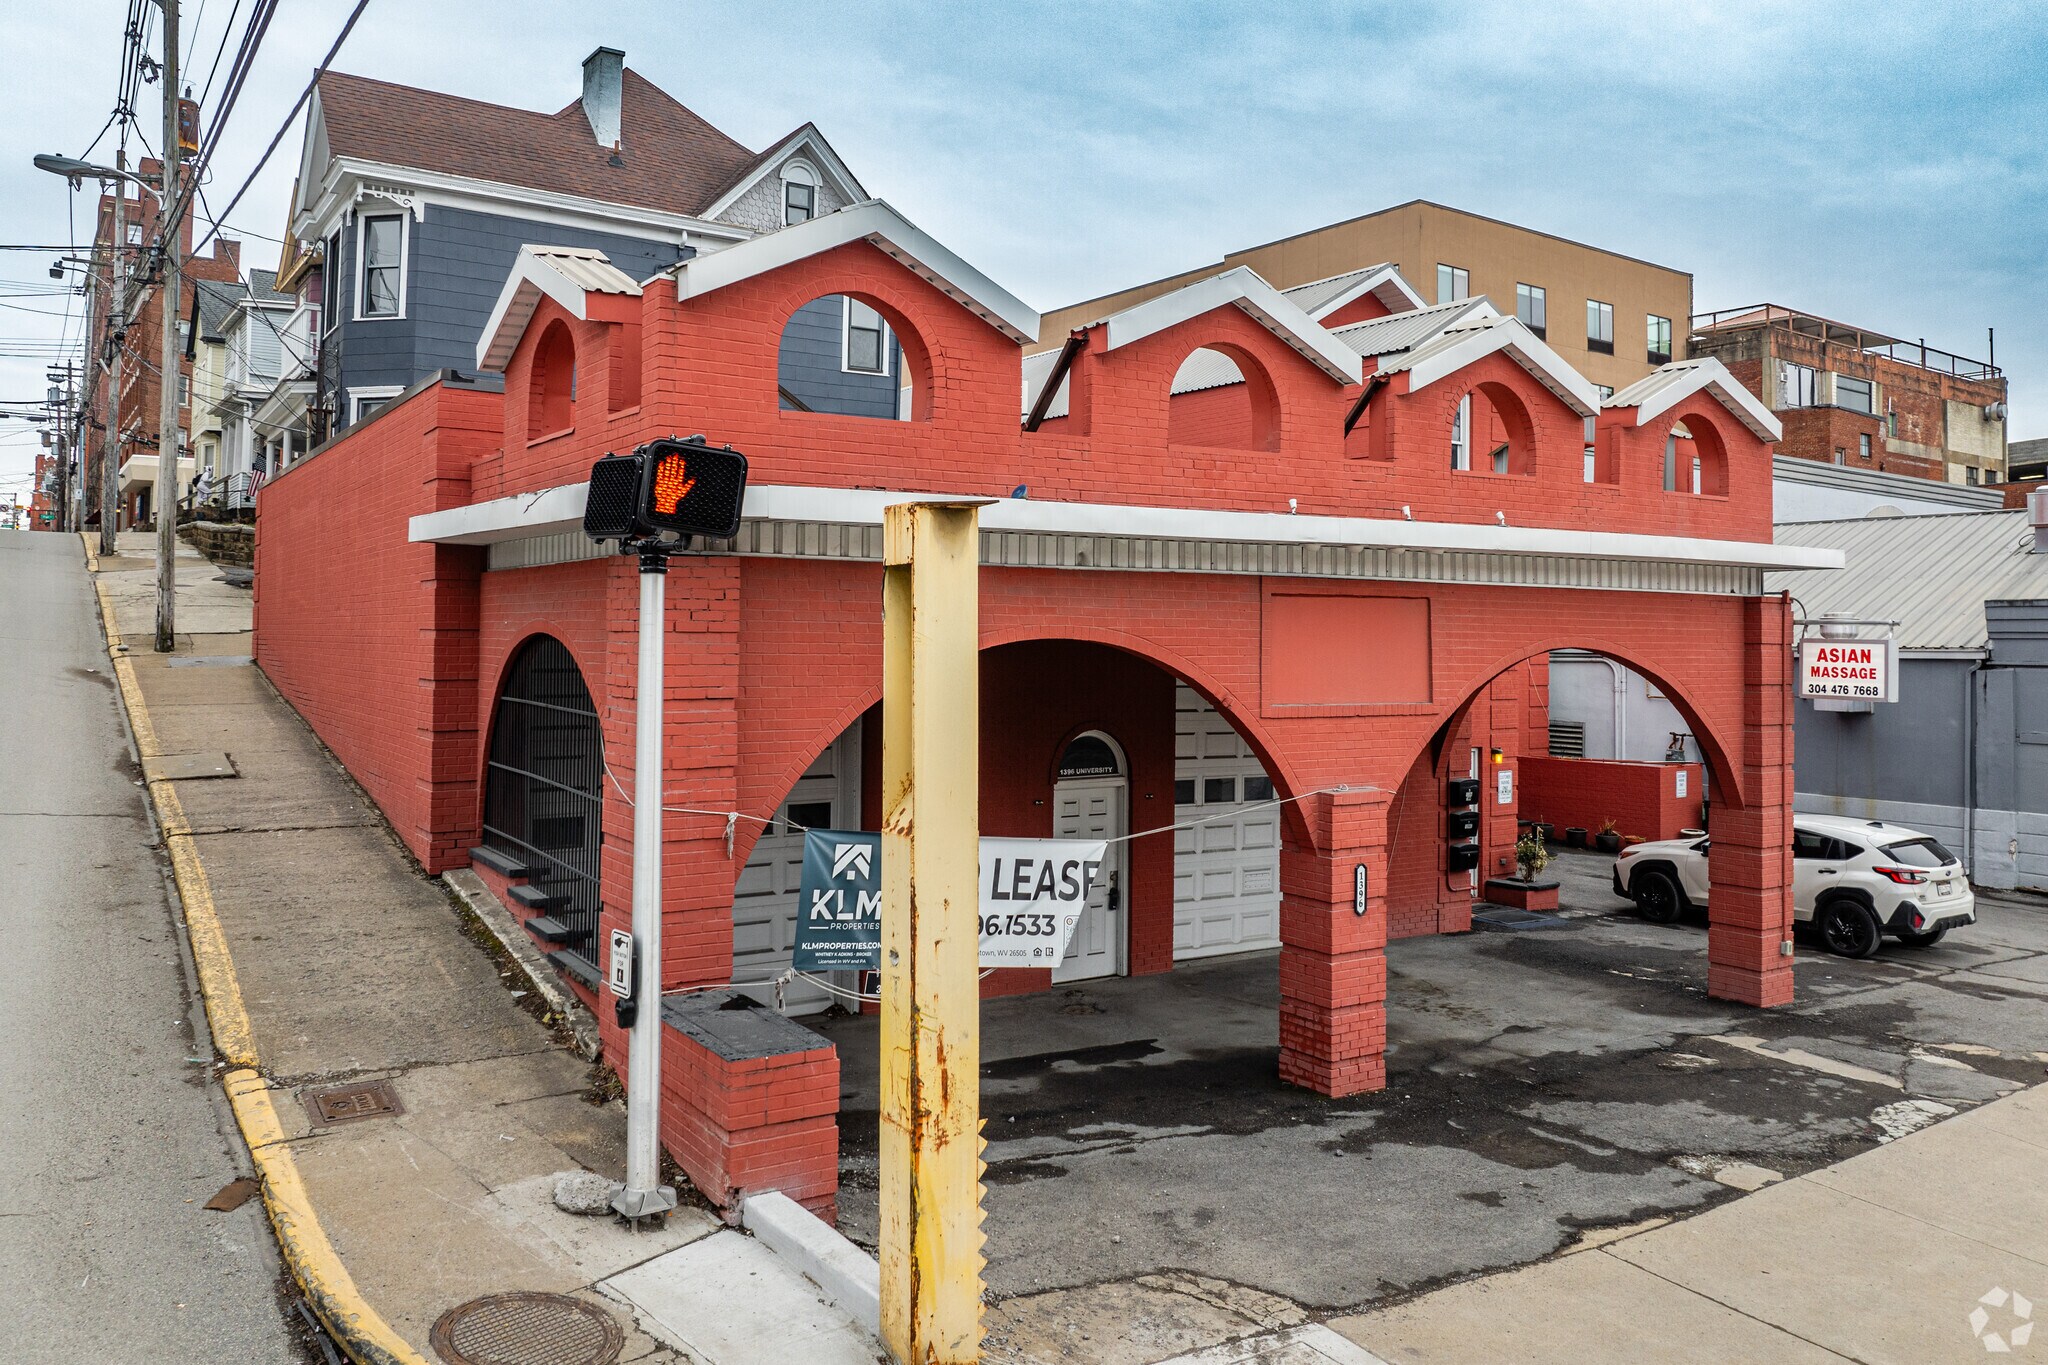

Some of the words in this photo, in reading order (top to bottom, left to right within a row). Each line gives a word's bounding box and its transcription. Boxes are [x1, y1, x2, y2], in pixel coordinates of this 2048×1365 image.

[1817, 648, 1871, 663] ASIAN
[1811, 666, 1877, 679] MASSAGE
[1808, 684, 1827, 693] 304
[1831, 685, 1849, 694] 476
[1853, 686, 1878, 696] 7668
[810, 889, 882, 919] KLM
[830, 922, 880, 930] PROPERTIES
